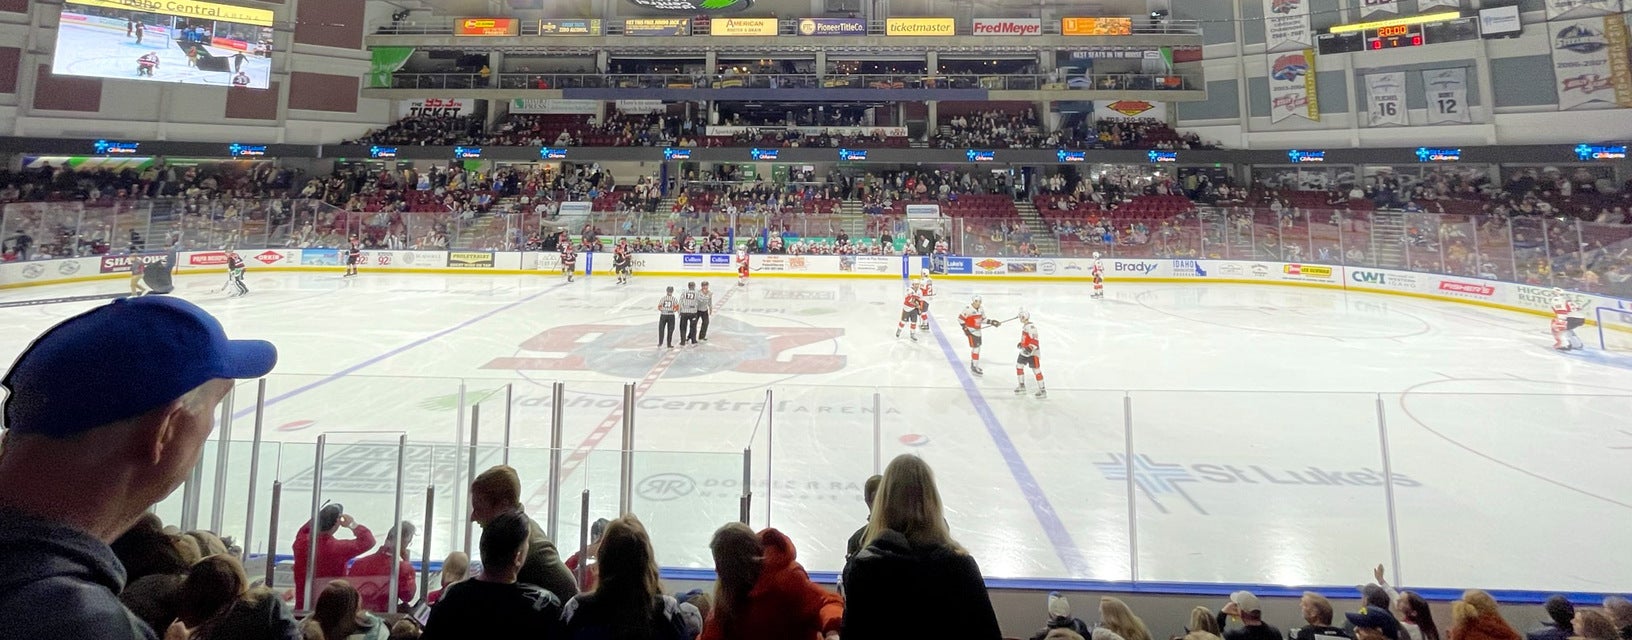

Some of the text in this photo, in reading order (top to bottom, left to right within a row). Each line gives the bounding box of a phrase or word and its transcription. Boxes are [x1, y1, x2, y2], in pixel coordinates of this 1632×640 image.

[166, 2, 221, 17] Central
[890, 22, 950, 32] ticketmaster
[1379, 25, 1407, 36] 20:00
[1373, 41, 1381, 49] 0
[1413, 36, 1421, 45] 0
[425, 98, 455, 107] 95.3
[1379, 102, 1397, 116] 16
[1438, 99, 1457, 114] 12
[410, 107, 461, 119] TICKET
[104, 255, 168, 268] SHAOWS
[1115, 262, 1151, 275] Brady
[1352, 271, 1385, 284] CWI
[637, 396, 792, 413] Central
[1249, 464, 1423, 488] Luke's
